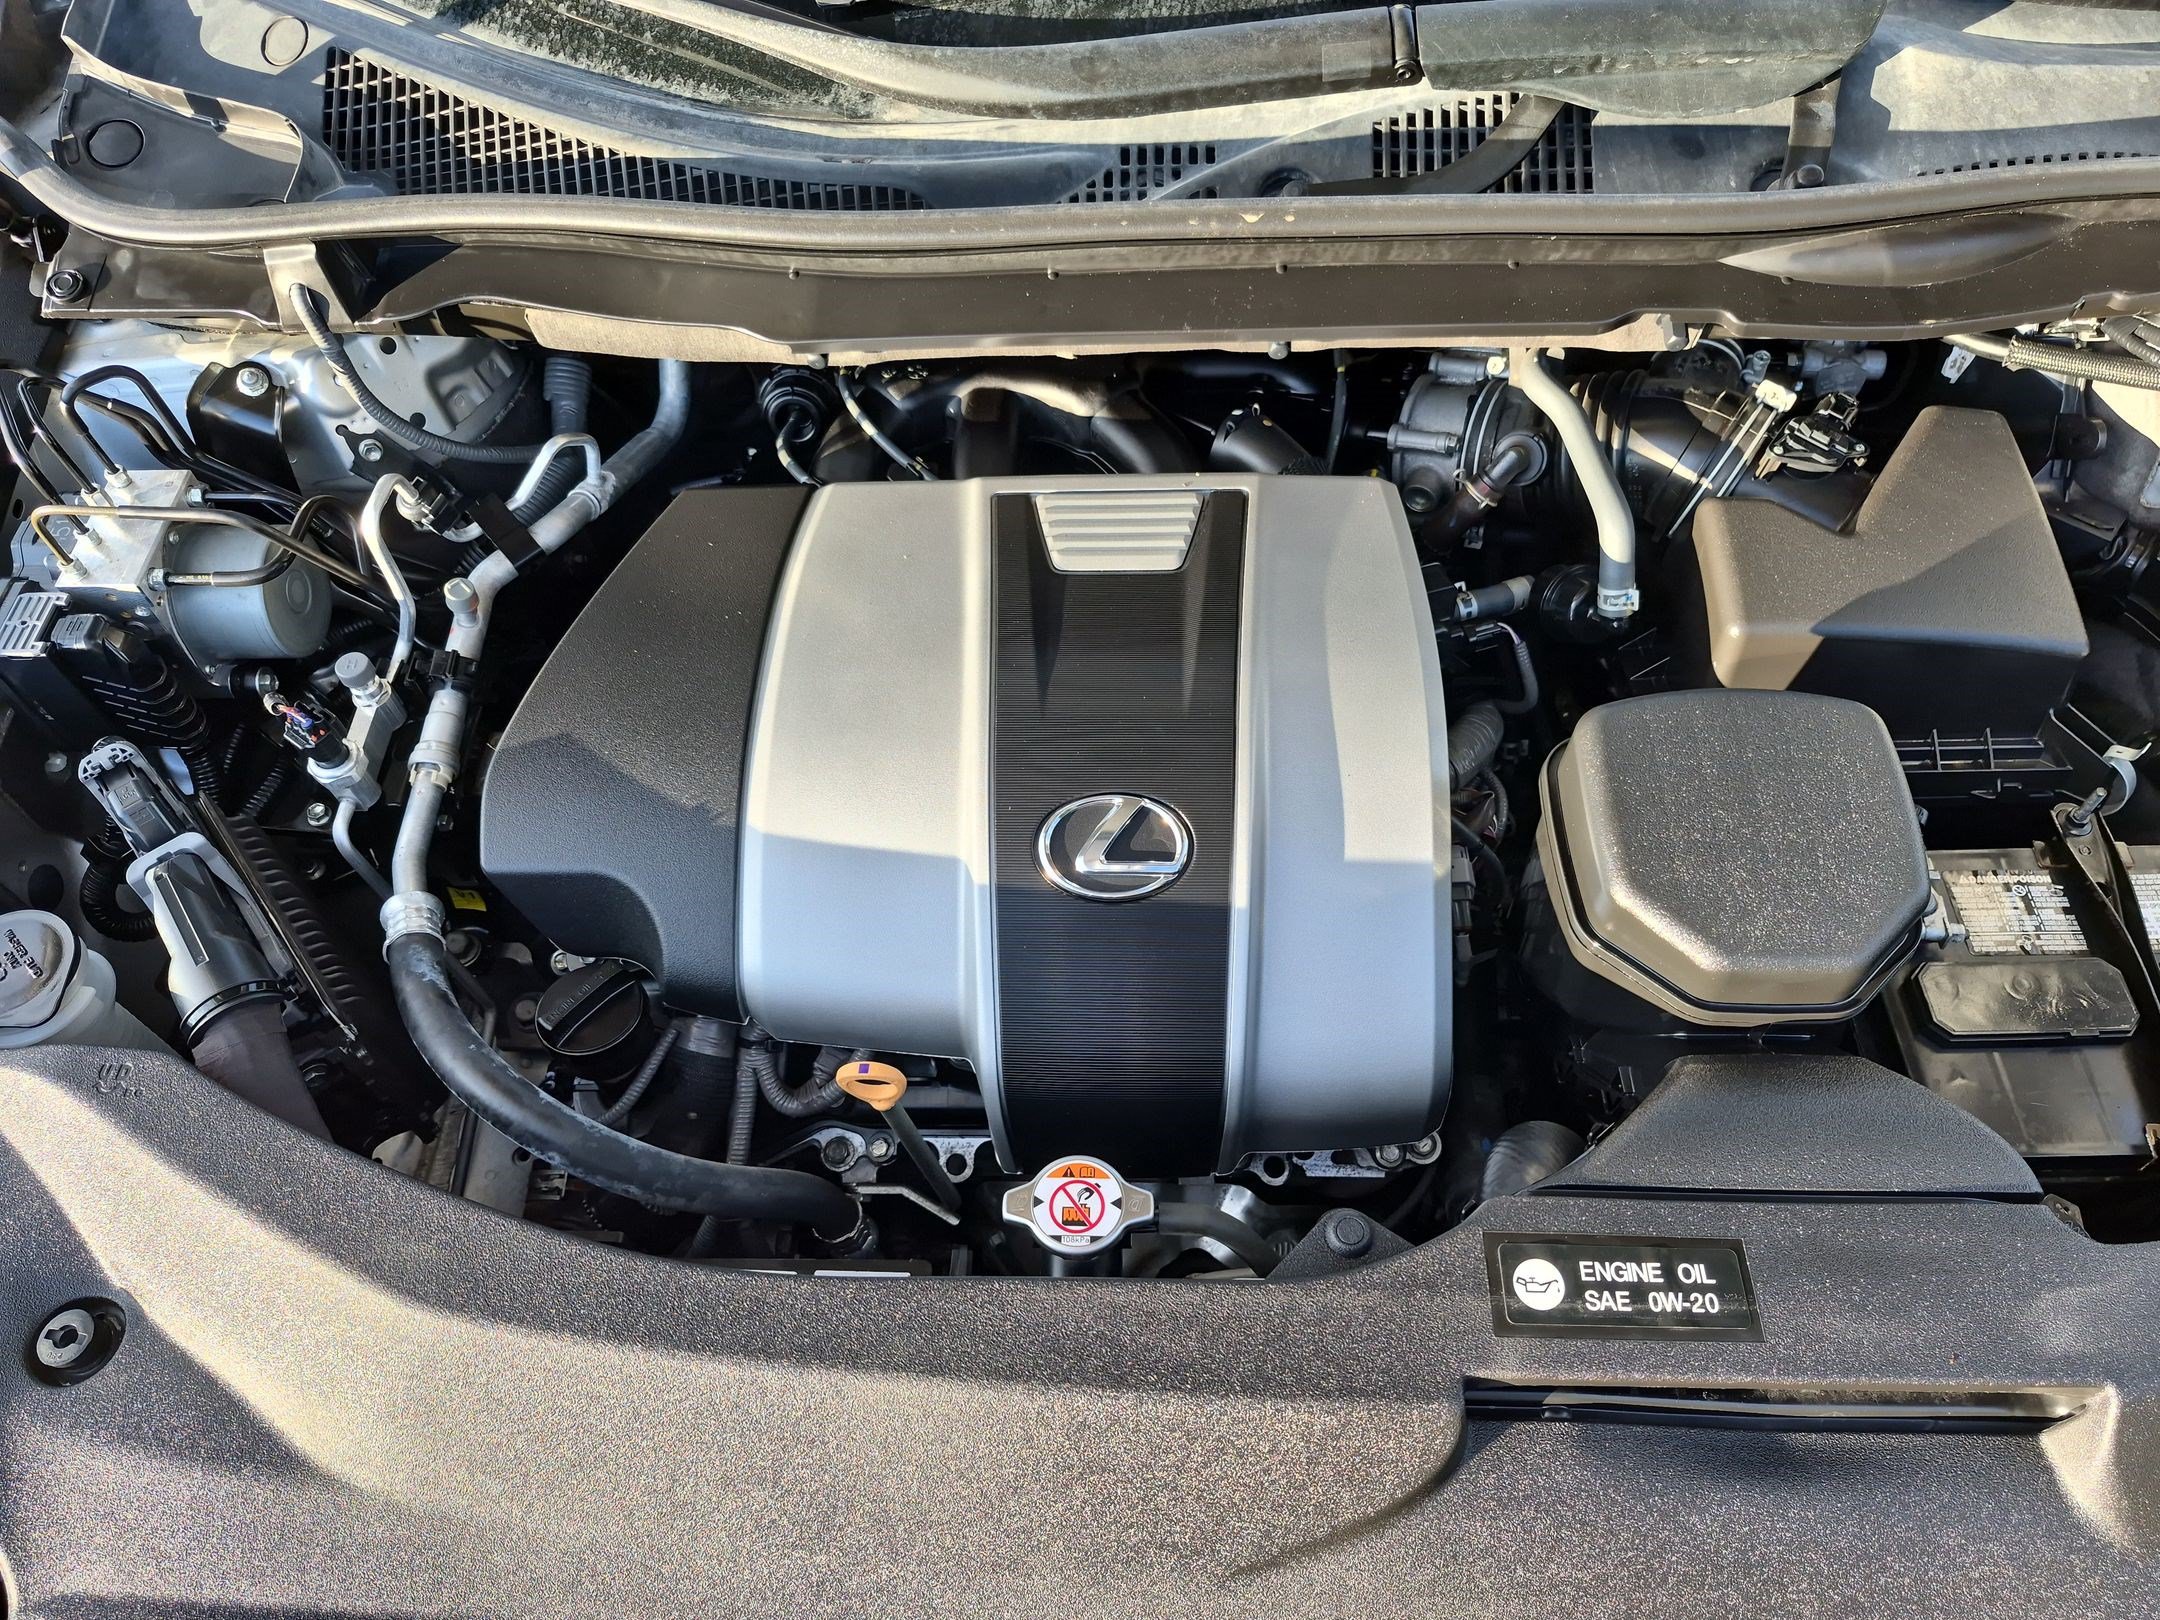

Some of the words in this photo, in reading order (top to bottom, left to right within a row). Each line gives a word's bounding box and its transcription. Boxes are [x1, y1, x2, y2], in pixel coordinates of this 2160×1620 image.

[1578, 1261, 1665, 1284] ENGINE
[1677, 1263, 1717, 1285] OIL
[1585, 1290, 1633, 1313] SAE
[1648, 1291, 1720, 1315] 0W-20
